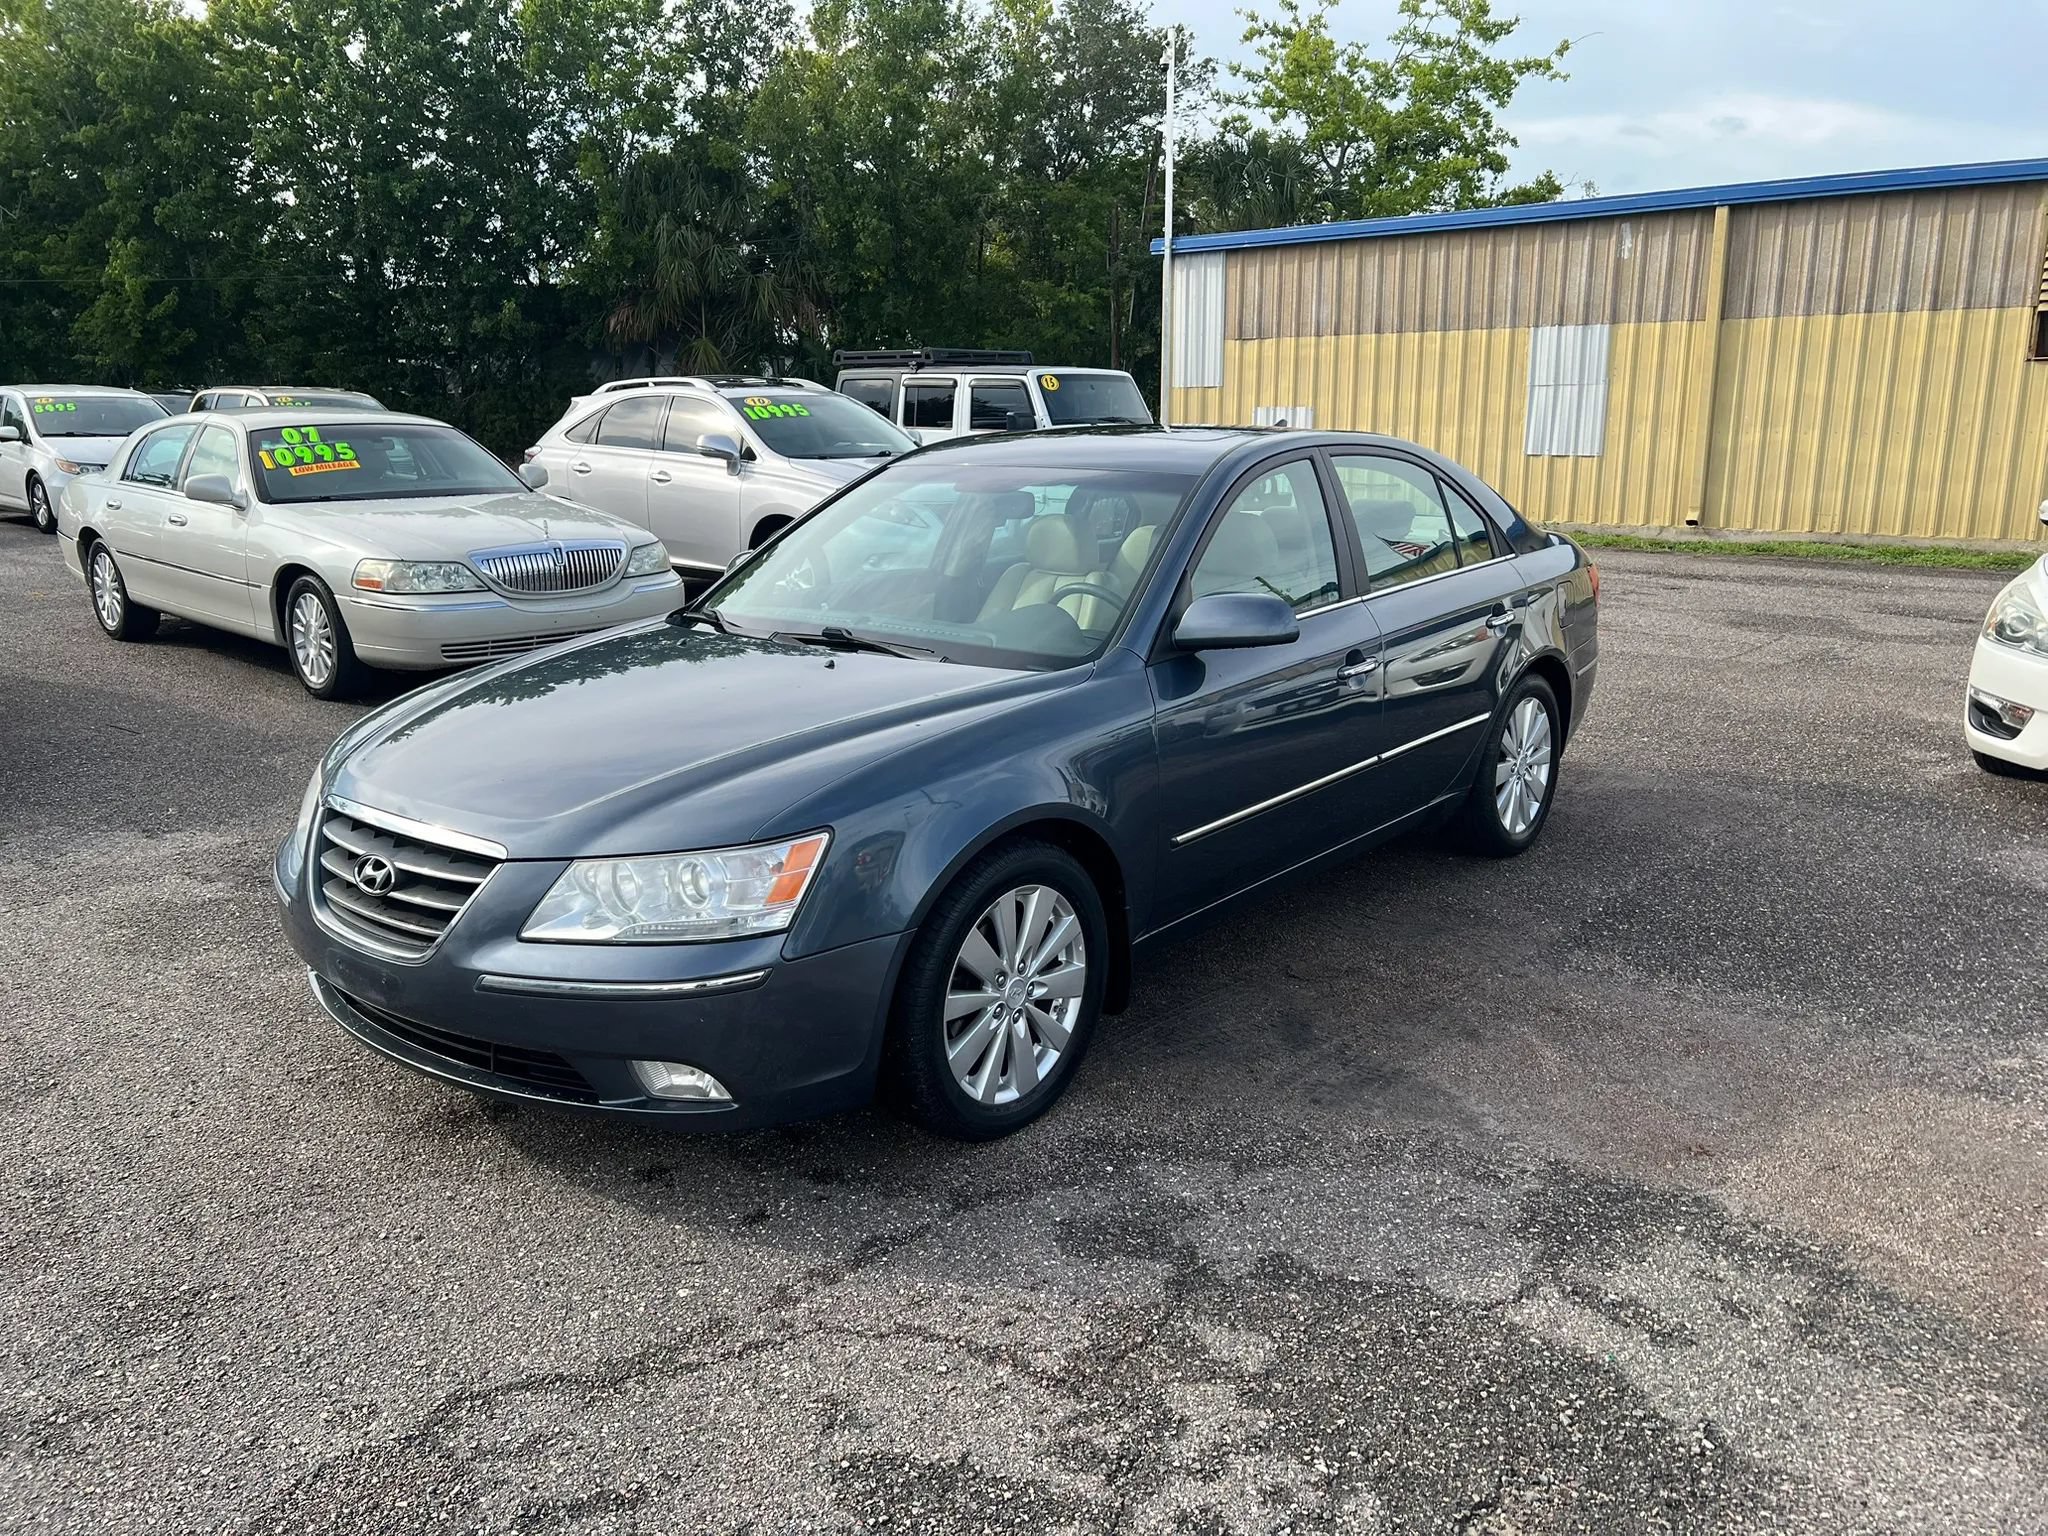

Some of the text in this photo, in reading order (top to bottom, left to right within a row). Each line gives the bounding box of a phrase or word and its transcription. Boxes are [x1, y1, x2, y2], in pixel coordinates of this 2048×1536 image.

[1045, 377, 1056, 388] 15
[743, 403, 810, 420] 10995
[281, 426, 321, 444] 07
[258, 442, 356, 470] 10995
[294, 460, 355, 475] LOW MILEAGE
